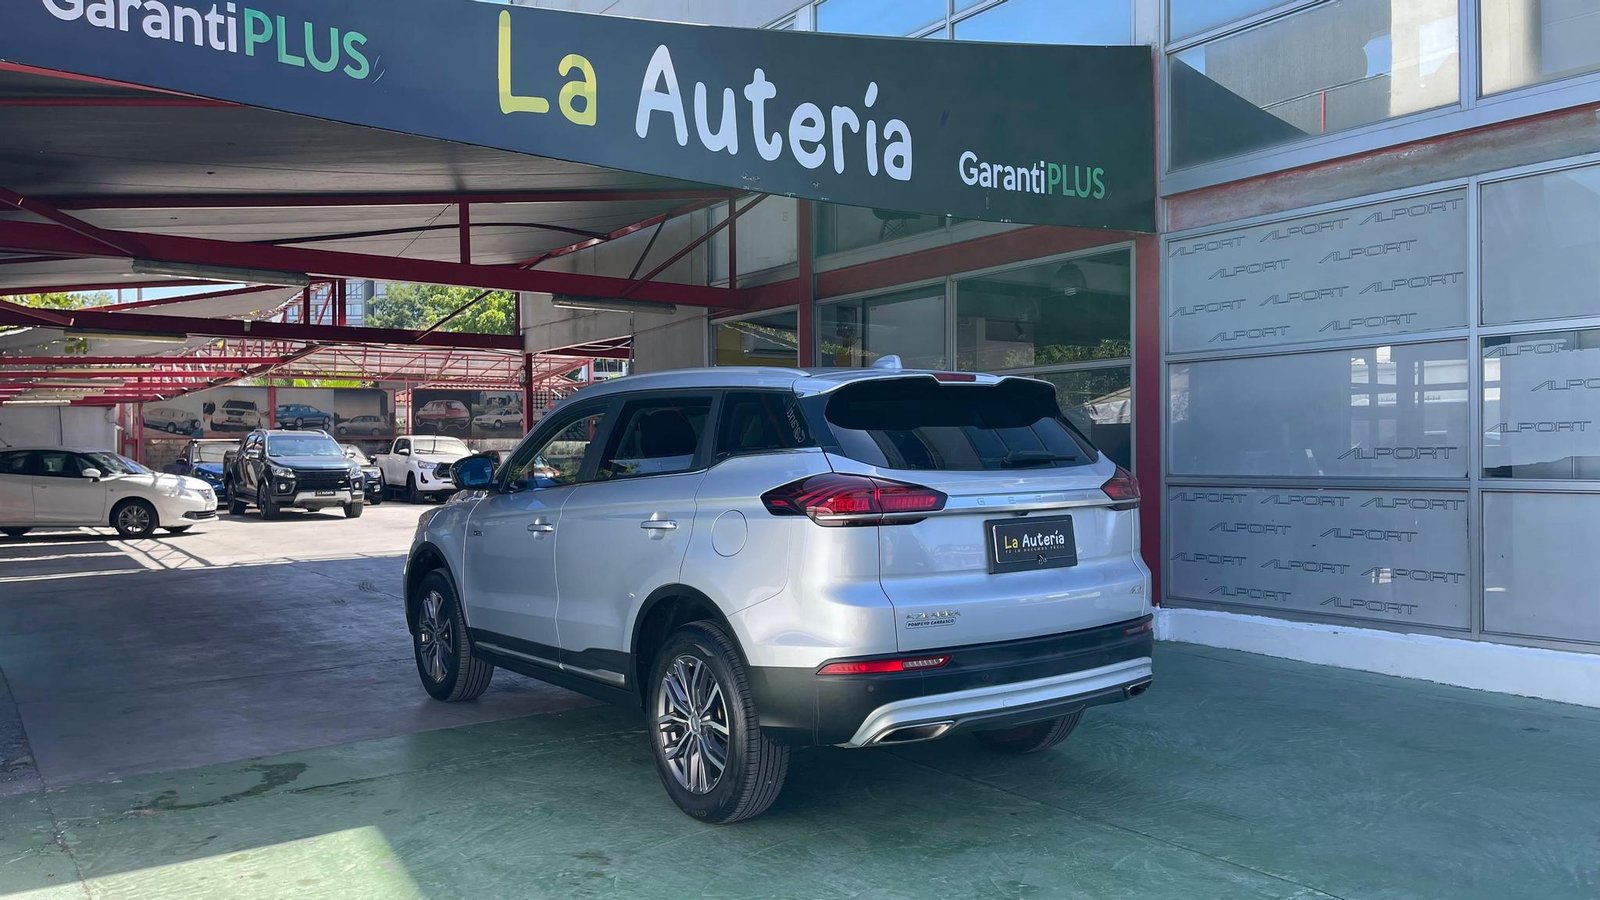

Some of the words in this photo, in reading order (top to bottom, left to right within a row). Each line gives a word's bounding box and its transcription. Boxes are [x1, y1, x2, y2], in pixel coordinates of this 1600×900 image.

[497, 10, 598, 127] La
[635, 44, 913, 182] Autería
[959, 150, 1106, 200] GarantiPLUS
[1169, 236, 1246, 258] ALPORT
[1259, 217, 1349, 242] ALPORT
[1359, 198, 1464, 225] ALPORT
[1208, 259, 1290, 280] ALPORT
[1319, 240, 1417, 263] ALPORT
[1169, 299, 1246, 317] ALPORT
[1259, 286, 1349, 306] ALPORT
[1359, 272, 1464, 294] ALPORT
[1208, 325, 1290, 343] ALPORT
[1318, 313, 1417, 332] ALPORT
[1484, 343, 1580, 357] ALPOR
[1484, 421, 1592, 433] ALPORT
[1337, 446, 1457, 460] ALPORT
[1169, 492, 1247, 504] ALPORT
[1260, 494, 1350, 507] ALPORT
[1360, 497, 1465, 511] ALPORT
[1004, 535, 1019, 550] La
[1022, 530, 1065, 548] Autería
[1209, 522, 1292, 535] ALPORT
[1320, 527, 1418, 543] ALPORT
[1171, 552, 1247, 566] ALPORT
[1260, 558, 1350, 575] ALPORT
[1209, 585, 1292, 601] ALPORT
[1320, 596, 1418, 615] ALPORT
